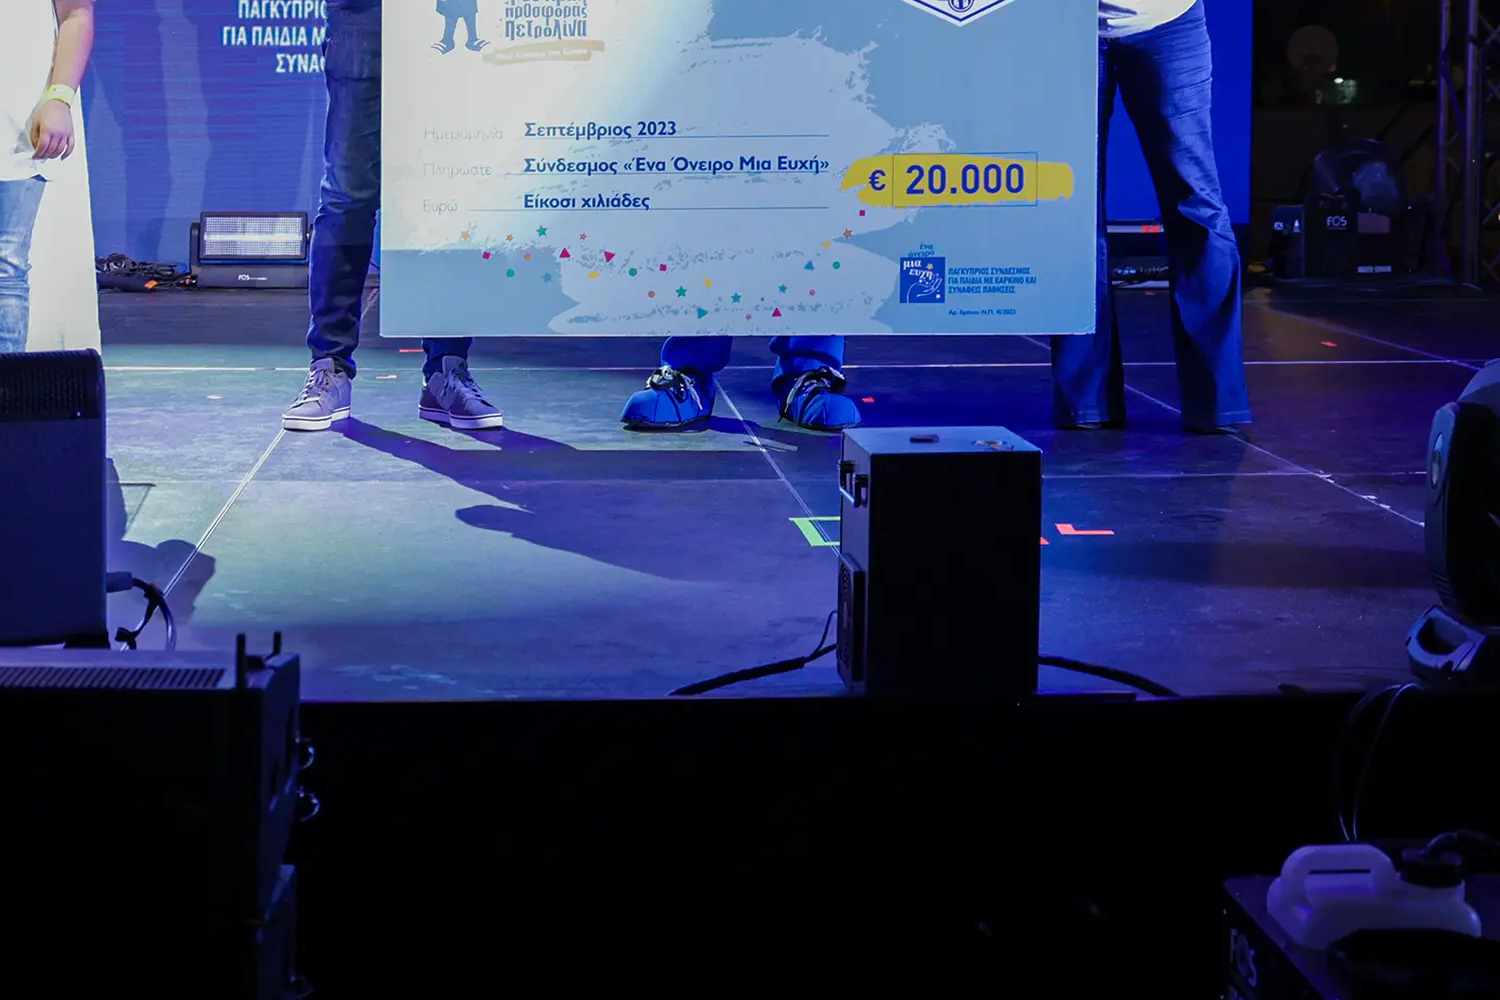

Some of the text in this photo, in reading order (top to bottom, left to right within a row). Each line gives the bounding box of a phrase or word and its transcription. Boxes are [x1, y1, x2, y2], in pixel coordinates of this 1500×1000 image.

[238, 0, 327, 19] ΠΑΓΚΥΠΡΙΟ
[223, 26, 326, 46] ΓΙΑ ΠΑΙΔΙΑ Μ
[524, 121, 632, 140] Σεπτέμβριος
[637, 120, 677, 136] 2023
[524, 157, 618, 176] Σύνδεσμος
[671, 156, 734, 175] Όνειρο
[739, 156, 772, 171] Μια
[777, 153, 830, 174] Ευχή»
[868, 163, 1025, 195] € 20.000
[524, 193, 576, 209] Είκοσι
[581, 192, 650, 211] χιλιάδες
[1326, 215, 1348, 227] FOS
[903, 260, 921, 270] μια
